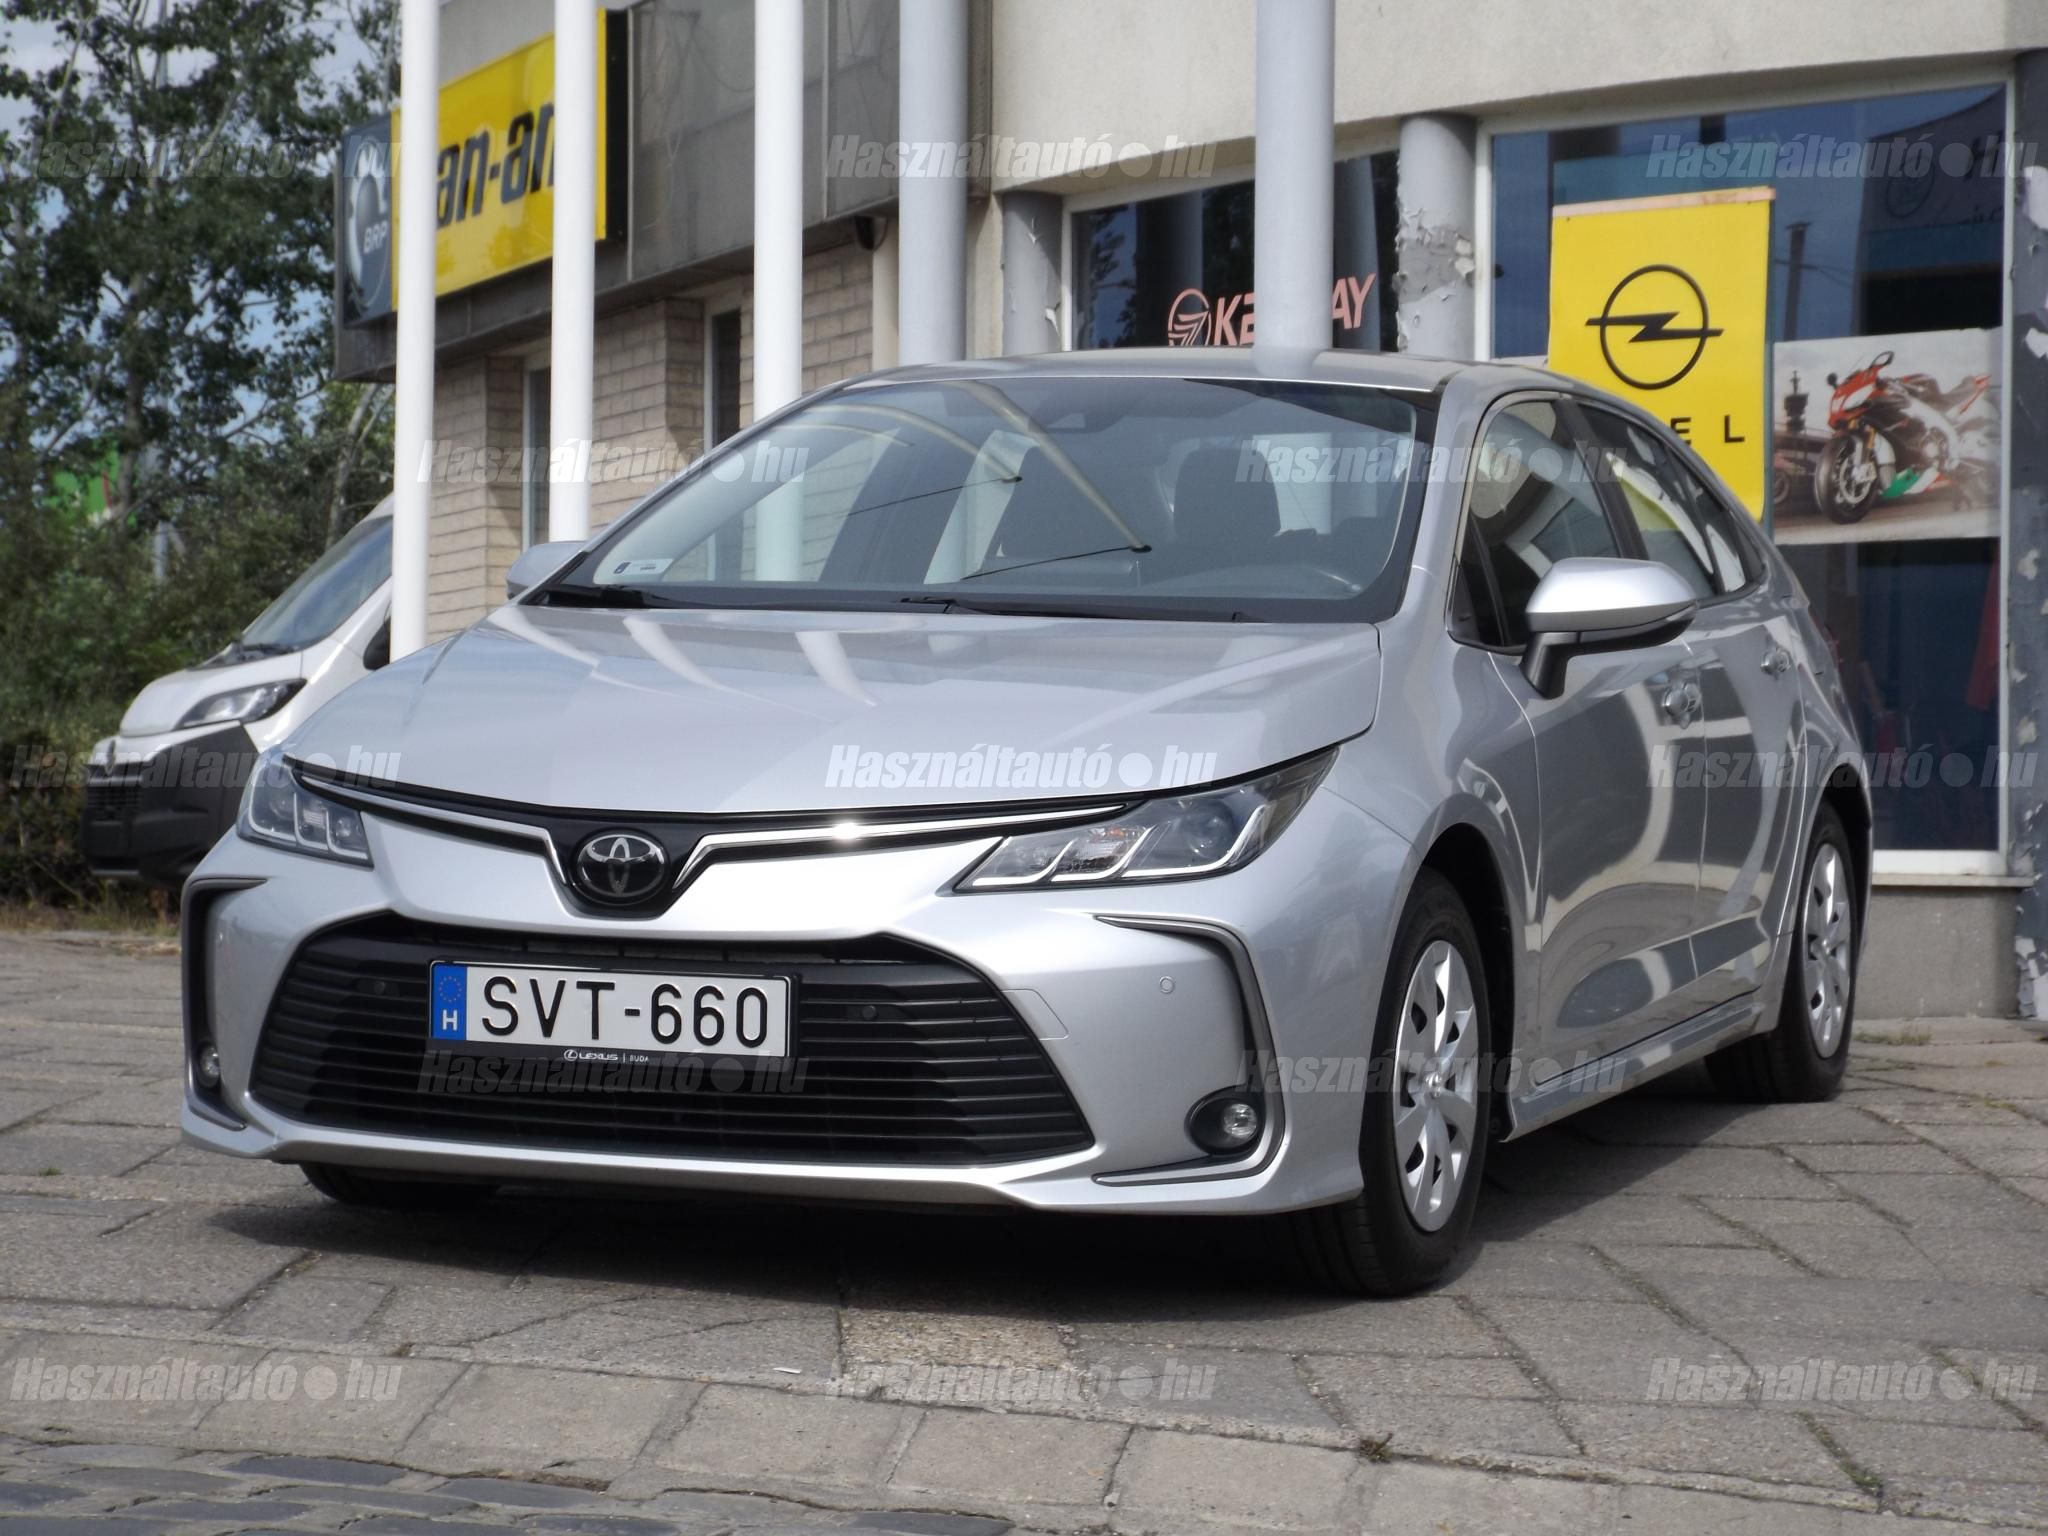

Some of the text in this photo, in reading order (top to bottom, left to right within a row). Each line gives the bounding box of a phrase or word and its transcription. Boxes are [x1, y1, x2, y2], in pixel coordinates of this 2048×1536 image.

[436, 103, 555, 231] an-a
[363, 221, 388, 254] BRP
[1670, 413, 1745, 446] EL
[442, 1009, 459, 1032] H
[481, 975, 768, 1049] SVT-660
